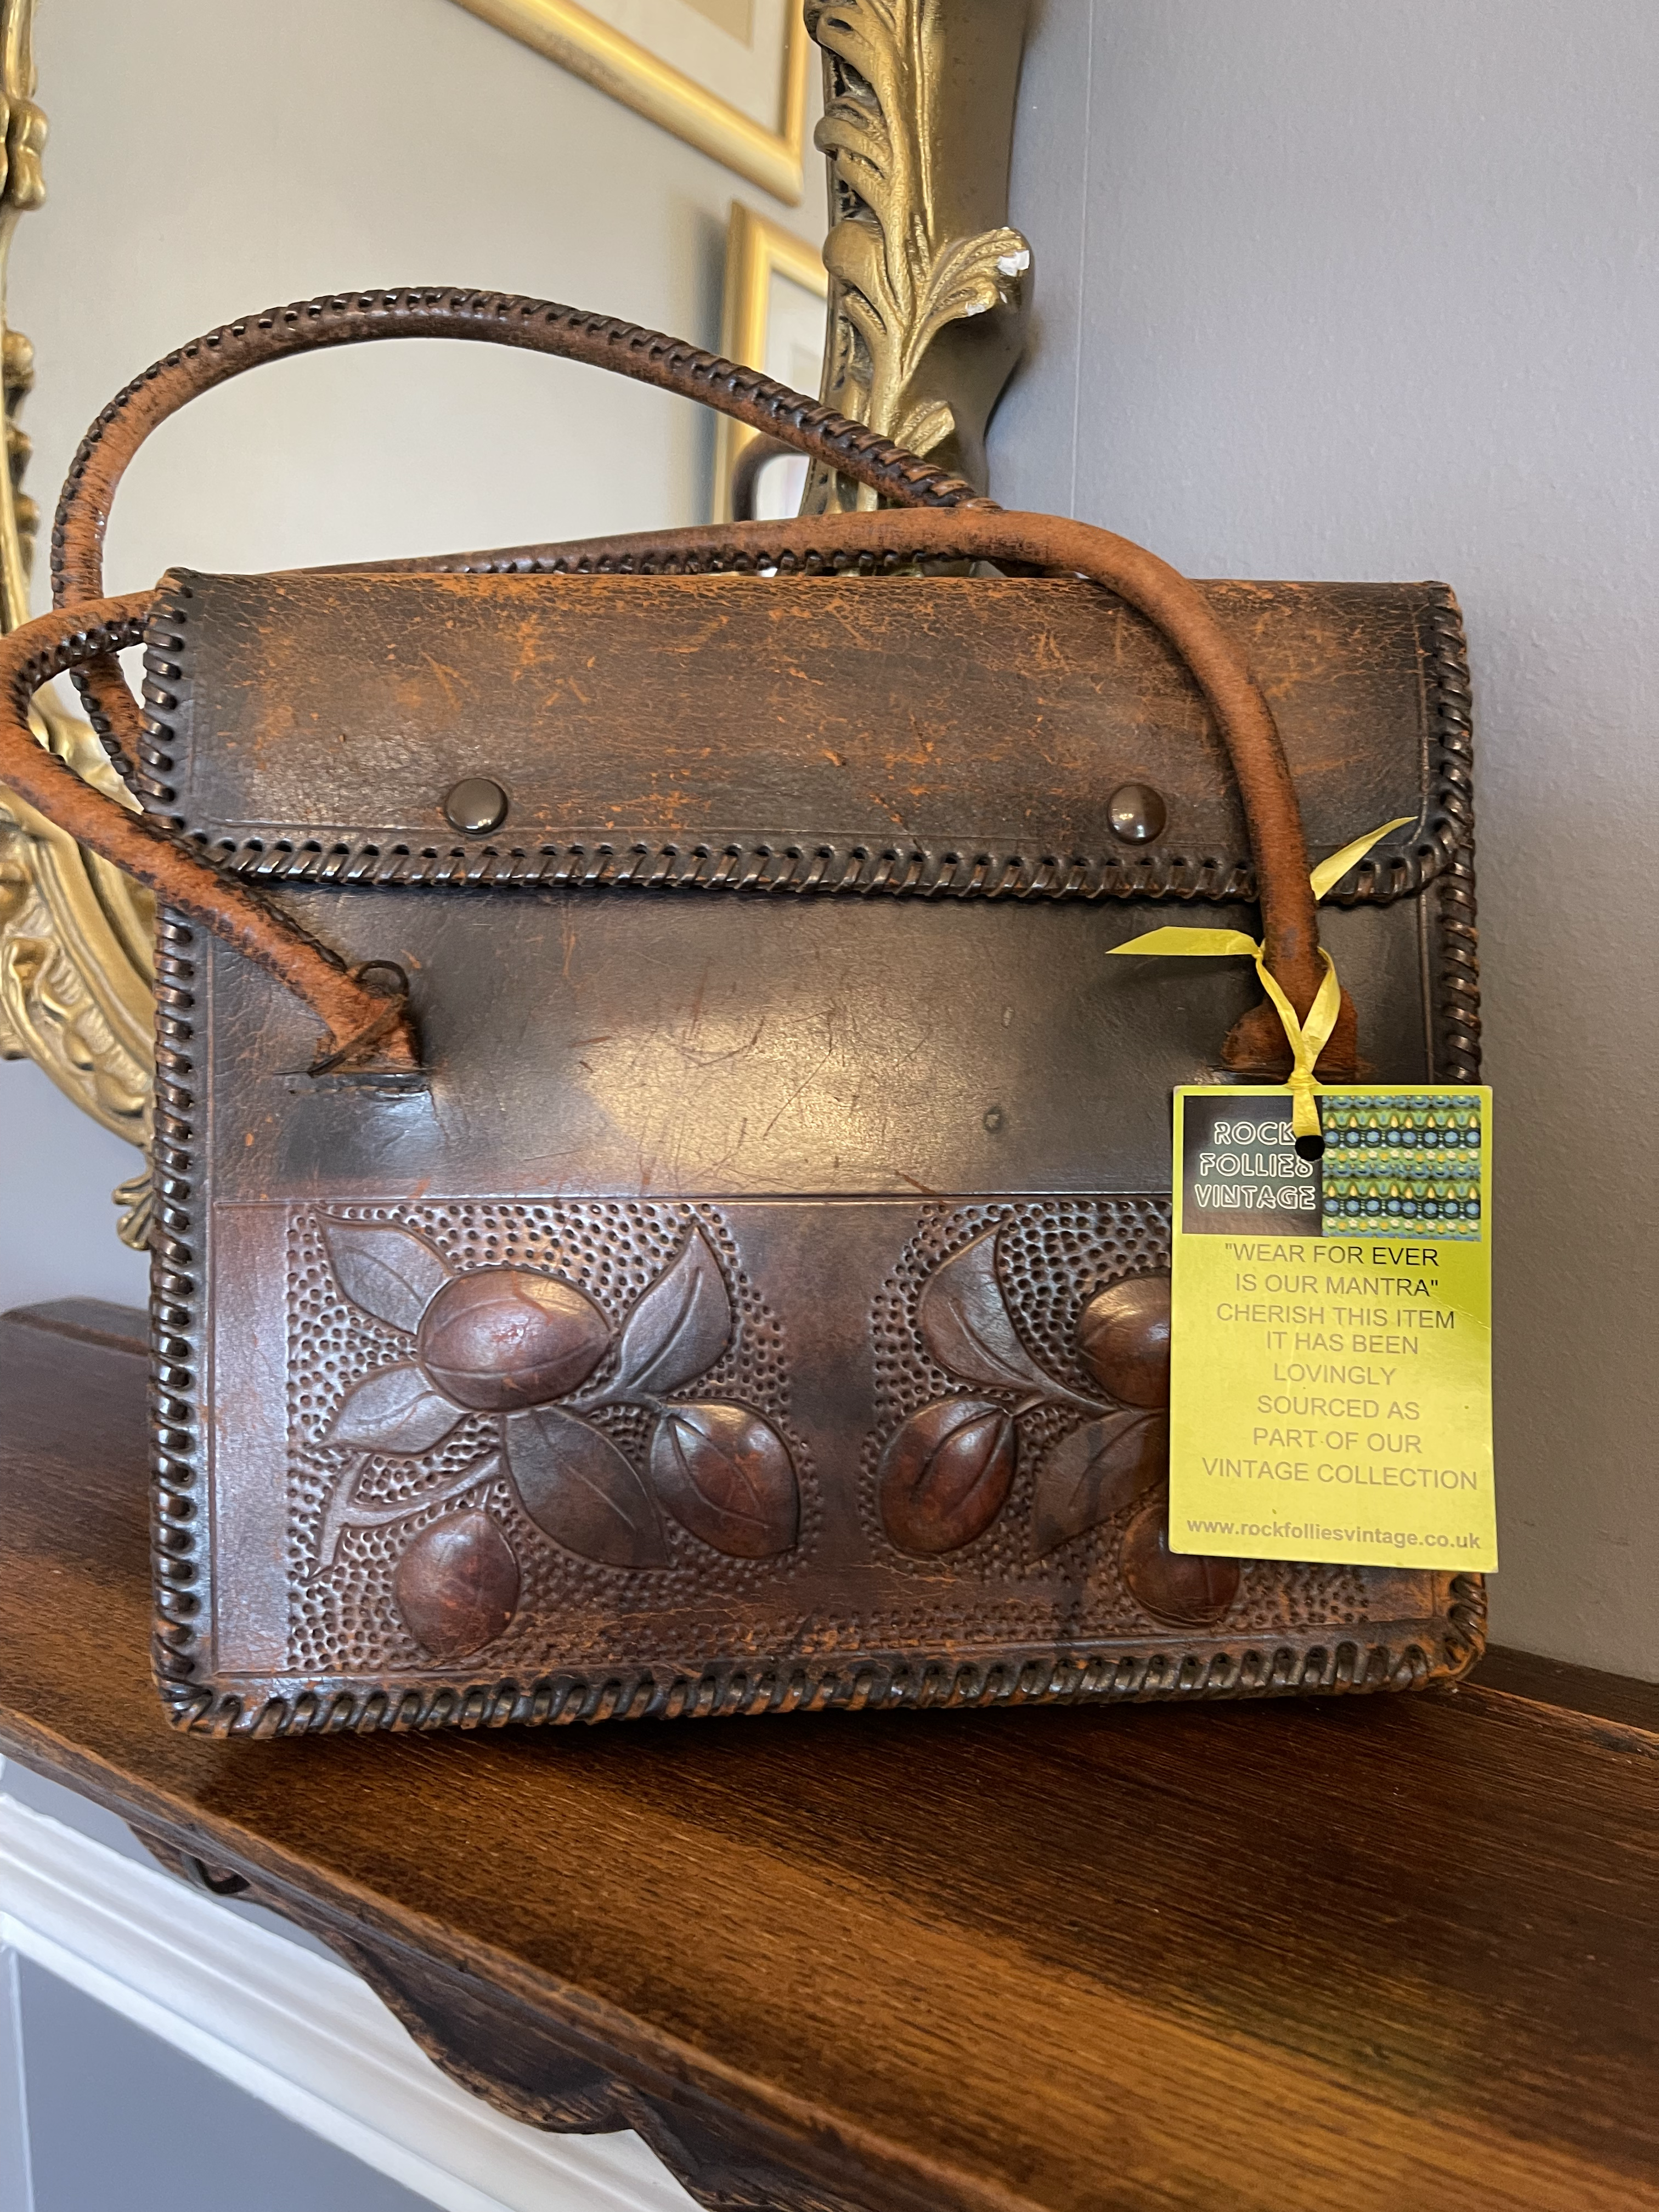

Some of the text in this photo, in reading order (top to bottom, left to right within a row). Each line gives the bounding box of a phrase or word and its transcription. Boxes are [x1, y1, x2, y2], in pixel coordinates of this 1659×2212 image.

[1195, 1184, 1316, 1210] VINTAGE
[1225, 1243, 1438, 1267] "WEAR FOR EVER
[1236, 1274, 1438, 1296] IS OUR MANTRA"
[1217, 1304, 1455, 1328] CHERISH THIS ITEM
[1267, 1331, 1418, 1354] IT HAS BEEN
[1274, 1363, 1397, 1385] LOVINGLY
[1257, 1395, 1420, 1420] SOURCED AS
[1254, 1428, 1422, 1453] PART OF OUR
[1202, 1457, 1477, 1489] VINTAGE COLLECTION
[1187, 1519, 1481, 1549] www.rockfolliesvintage.co.uk
